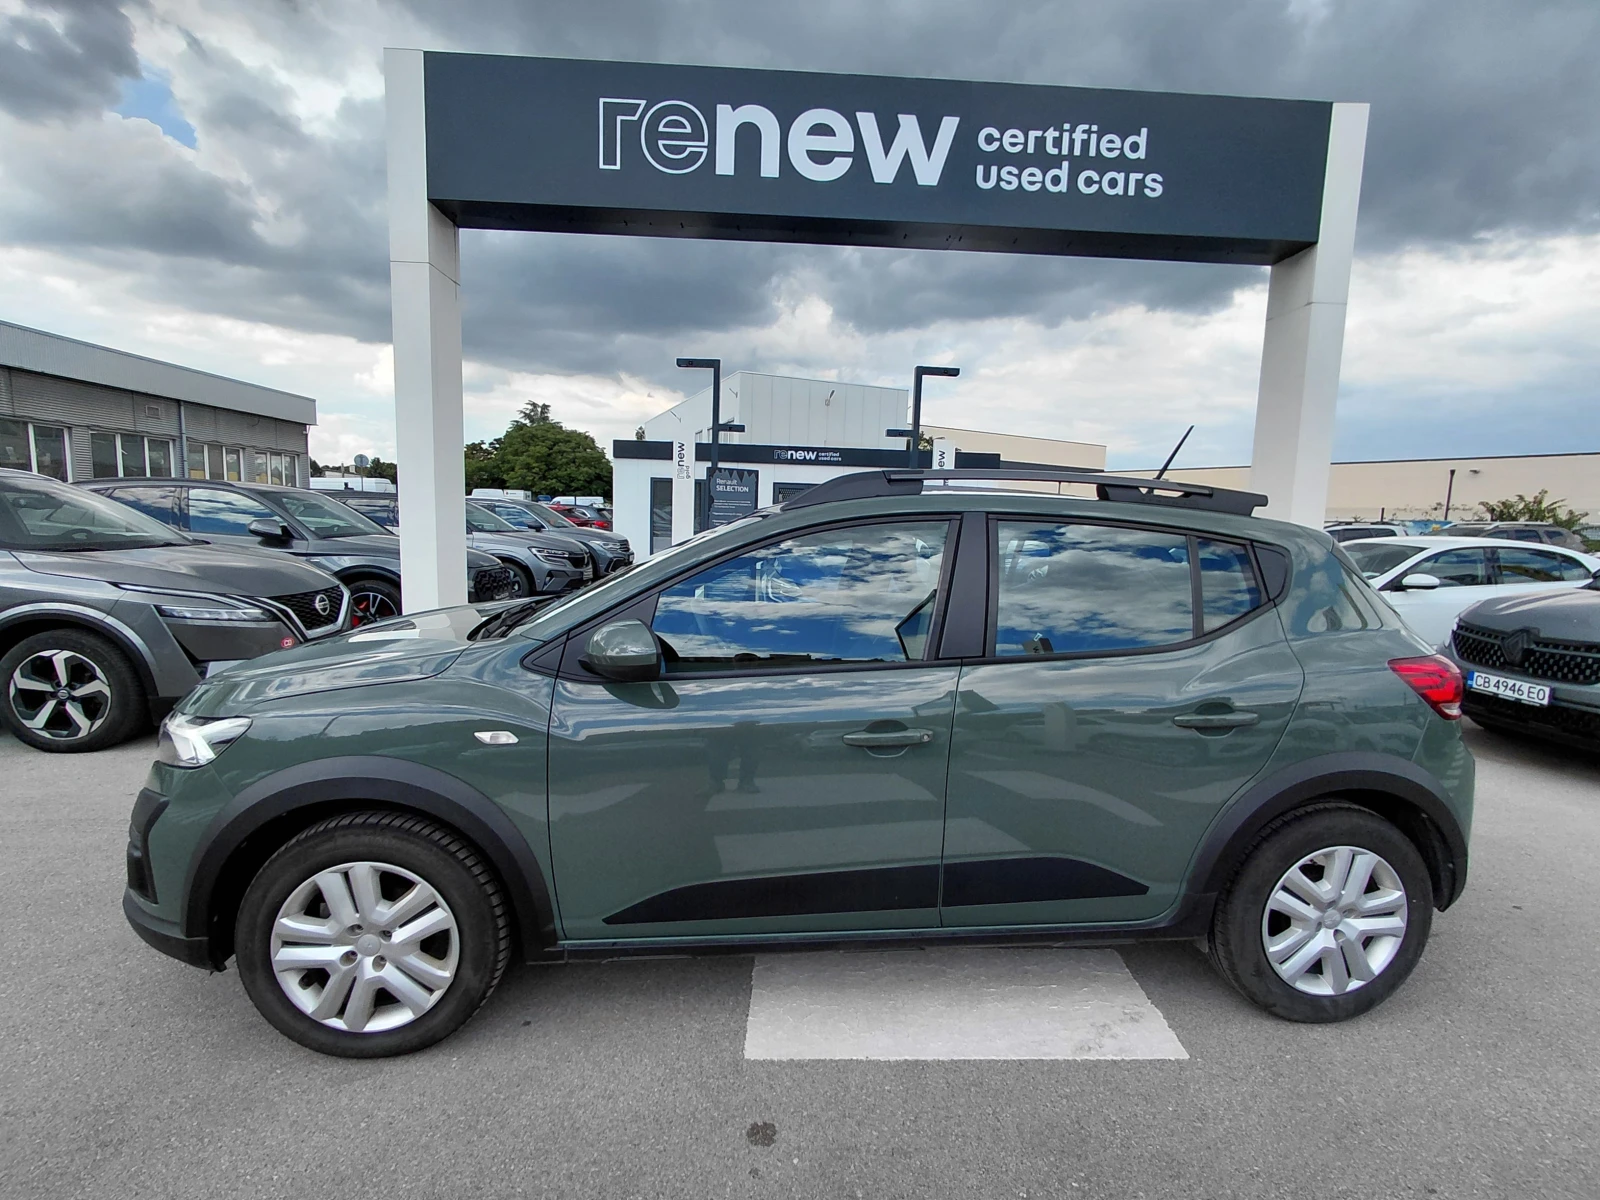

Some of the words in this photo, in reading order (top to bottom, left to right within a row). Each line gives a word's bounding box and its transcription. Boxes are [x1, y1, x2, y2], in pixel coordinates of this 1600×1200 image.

[598, 98, 960, 186] renew
[977, 123, 1148, 160] certified
[975, 160, 1071, 194] used
[1076, 169, 1165, 198] cars
[774, 450, 817, 460] renew
[1476, 674, 1490, 688] CB
[1493, 679, 1525, 697] 4946
